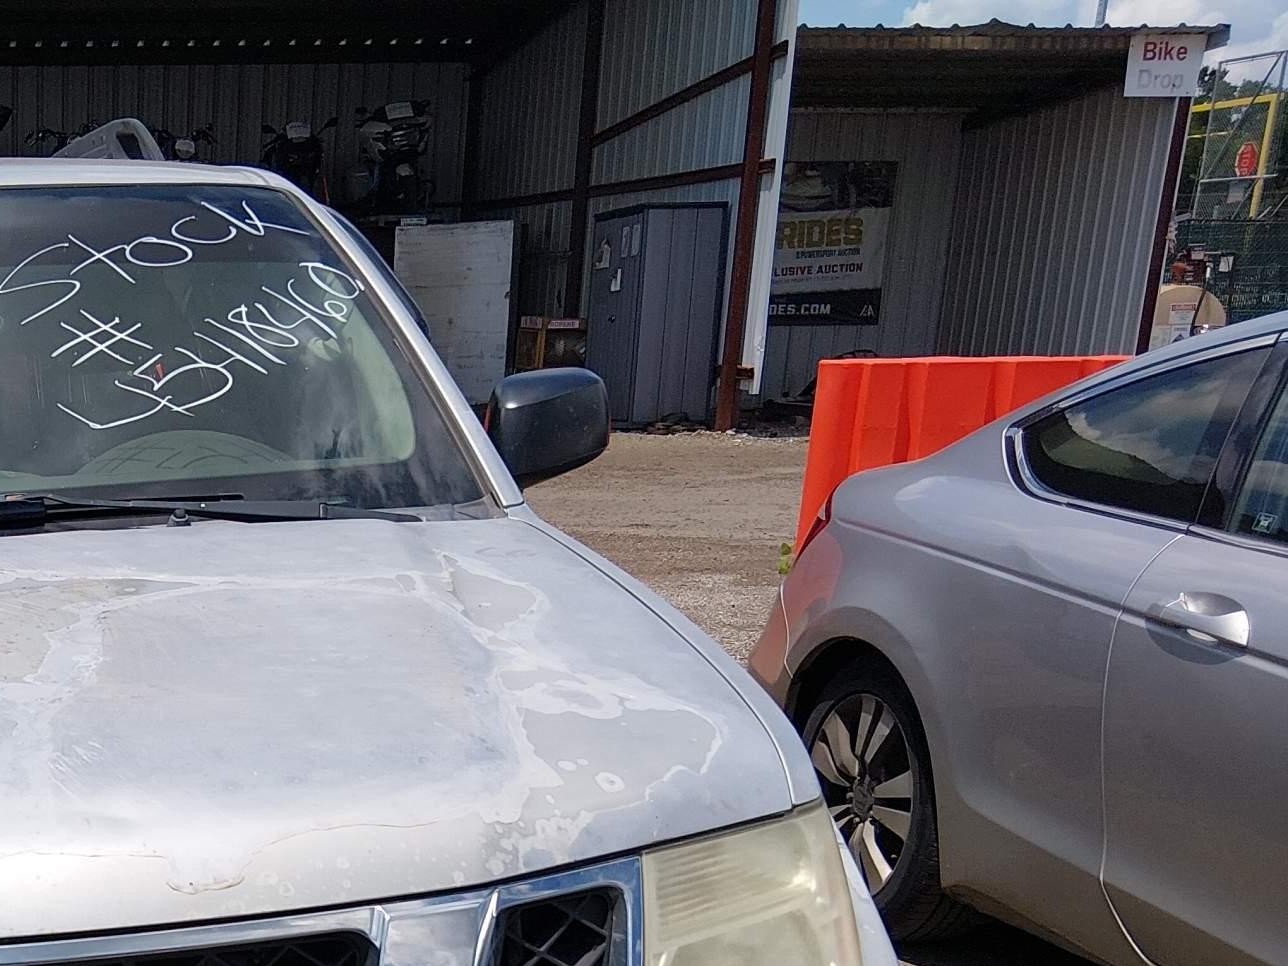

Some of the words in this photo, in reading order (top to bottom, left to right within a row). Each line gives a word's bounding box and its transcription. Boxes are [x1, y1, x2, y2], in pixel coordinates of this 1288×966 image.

[1143, 41, 1188, 60] Bike
[1137, 69, 1184, 92] Drop
[1240, 144, 1252, 176] STOP
[777, 217, 864, 249] RIDES
[775, 265, 813, 277] LUSIVE
[817, 263, 864, 275] AUCTION
[769, 303, 831, 316] DES.COM
